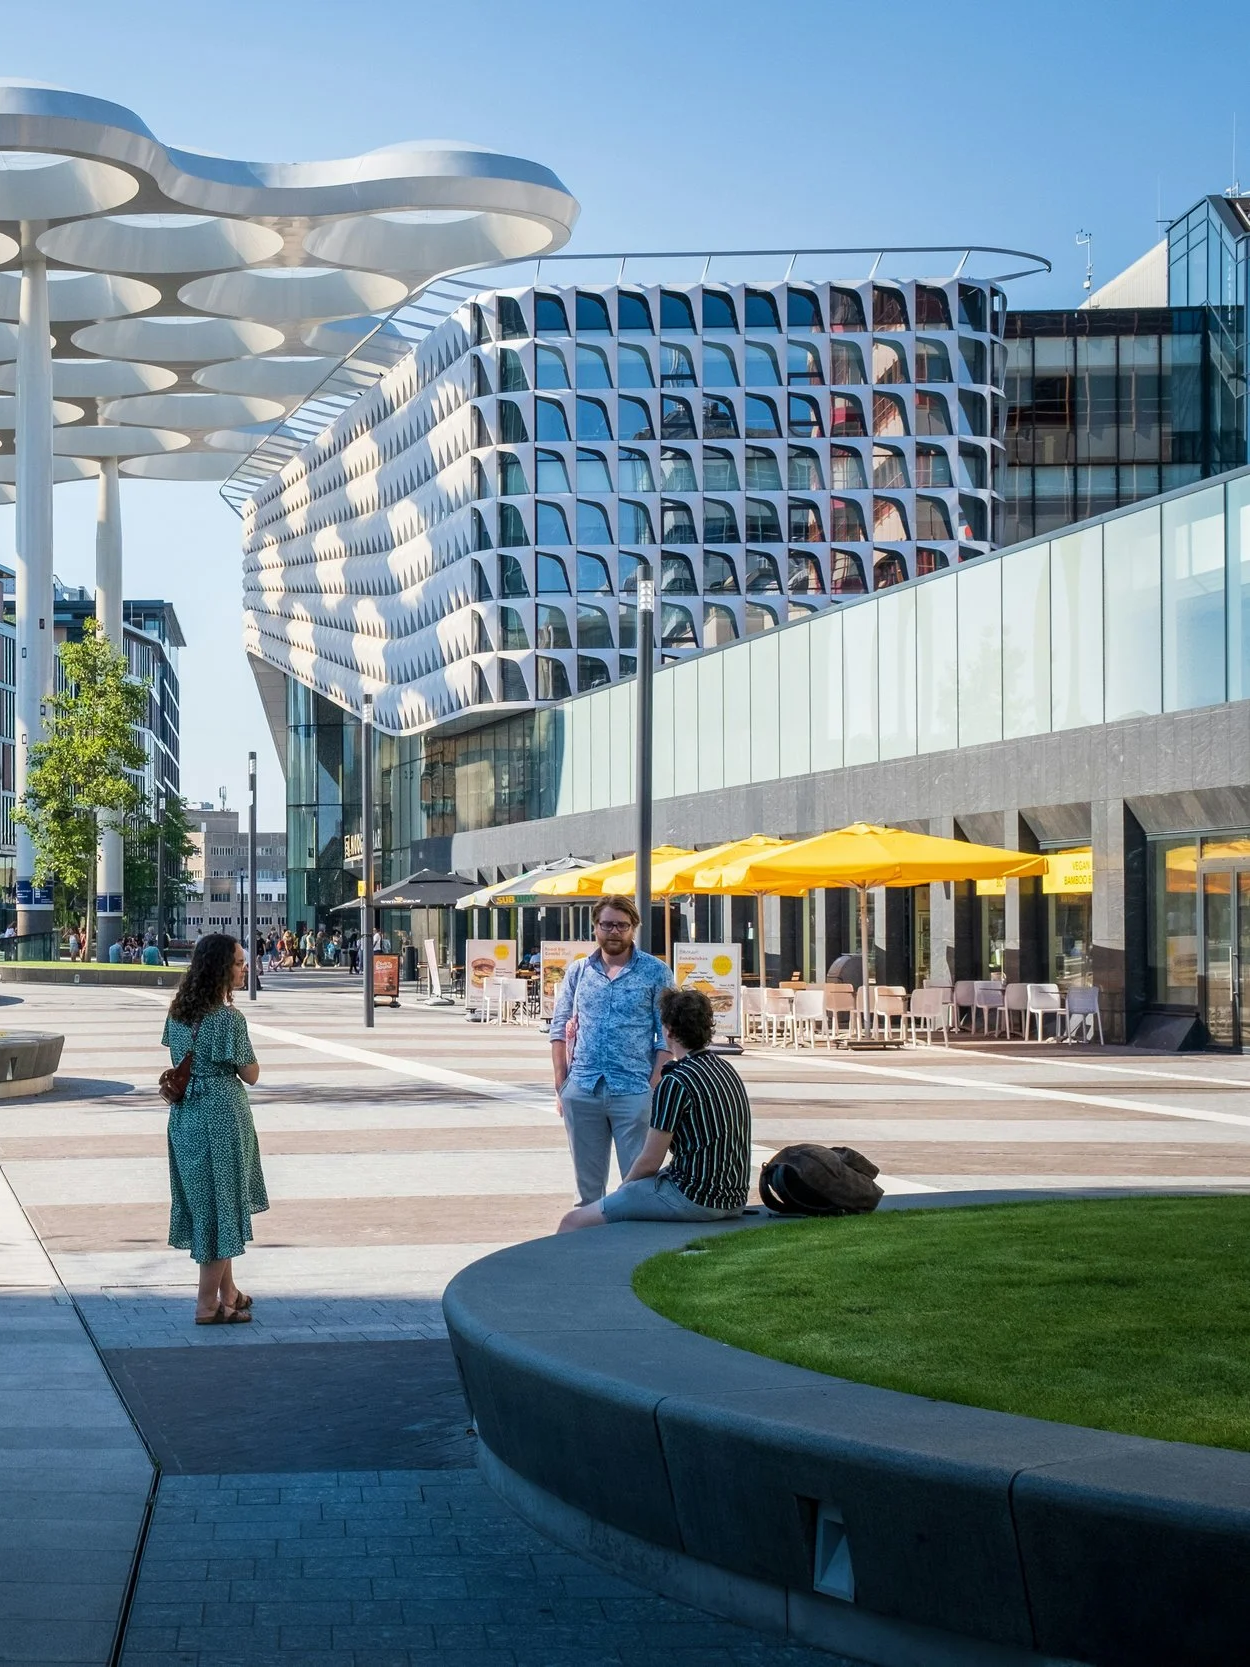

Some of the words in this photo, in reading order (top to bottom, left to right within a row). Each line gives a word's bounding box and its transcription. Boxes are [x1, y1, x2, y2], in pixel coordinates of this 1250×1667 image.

[1072, 861, 1090, 870] VEGAN
[1064, 875, 1087, 885] BAMBOO
[496, 894, 537, 904] SUBWAY
